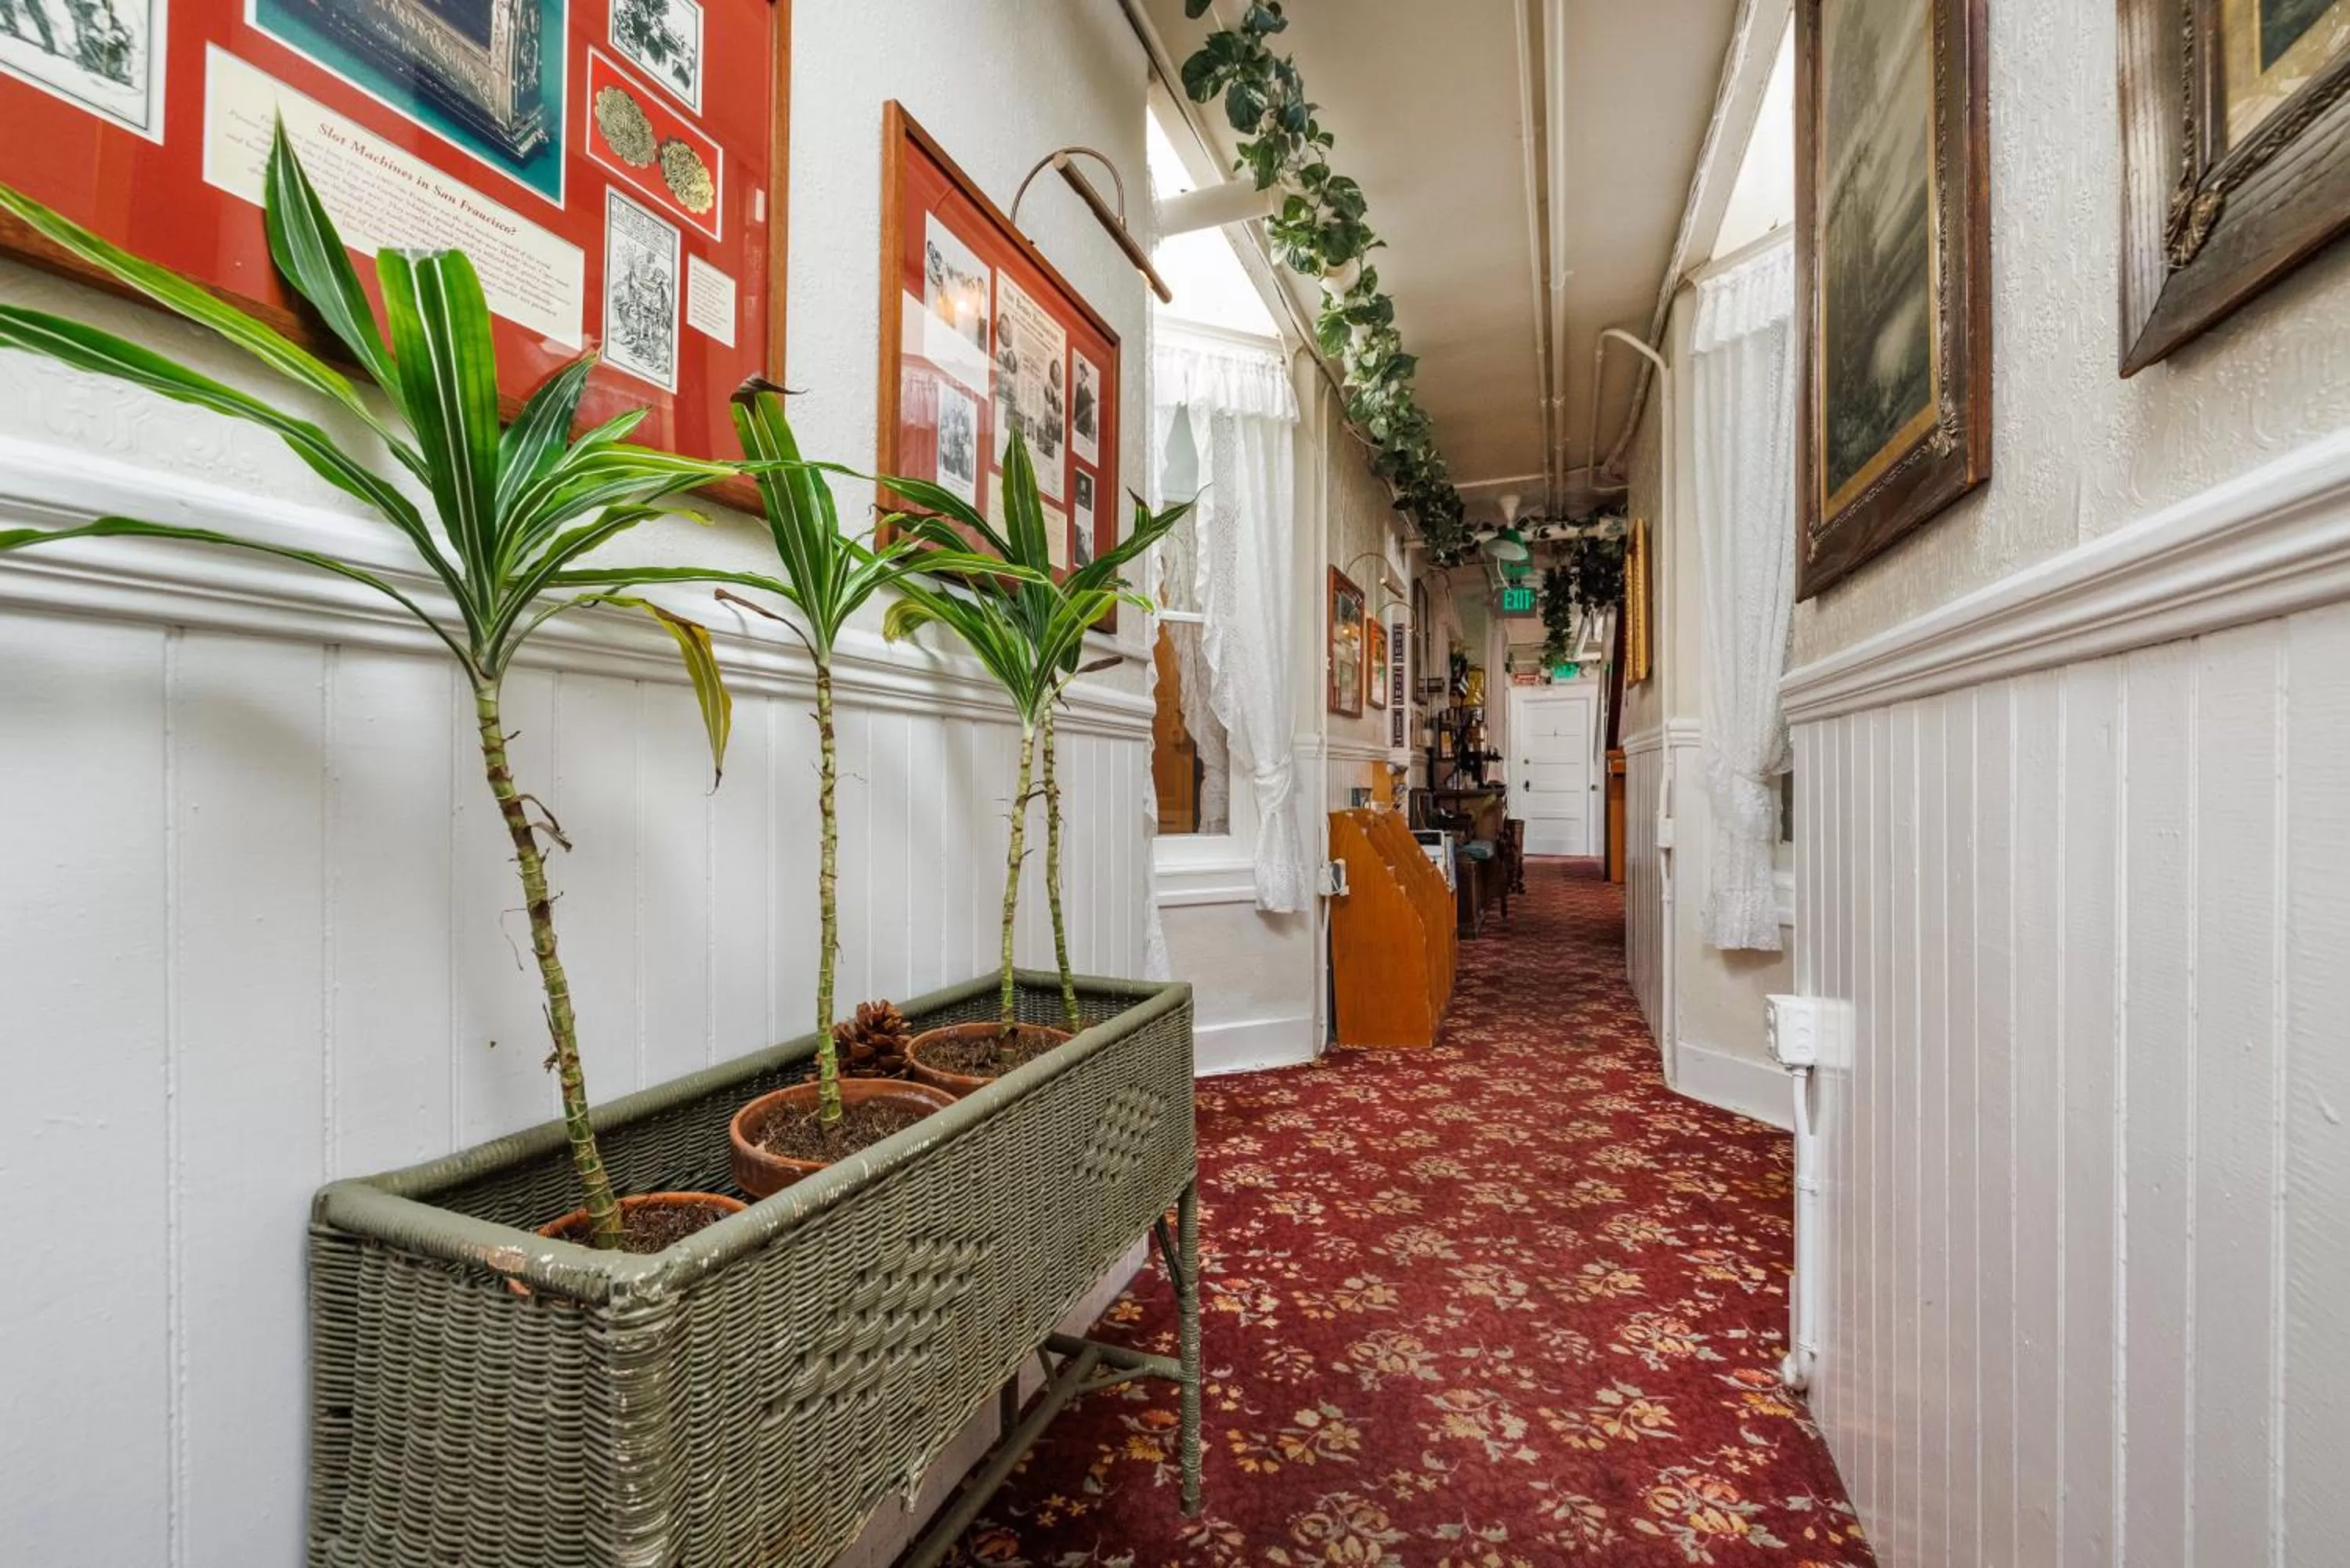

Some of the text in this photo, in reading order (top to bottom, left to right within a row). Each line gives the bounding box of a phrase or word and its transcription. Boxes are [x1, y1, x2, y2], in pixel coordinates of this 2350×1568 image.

[320, 123, 518, 236] Slot Machines in San Francisco?
[1503, 589, 1531, 609] EXIT
